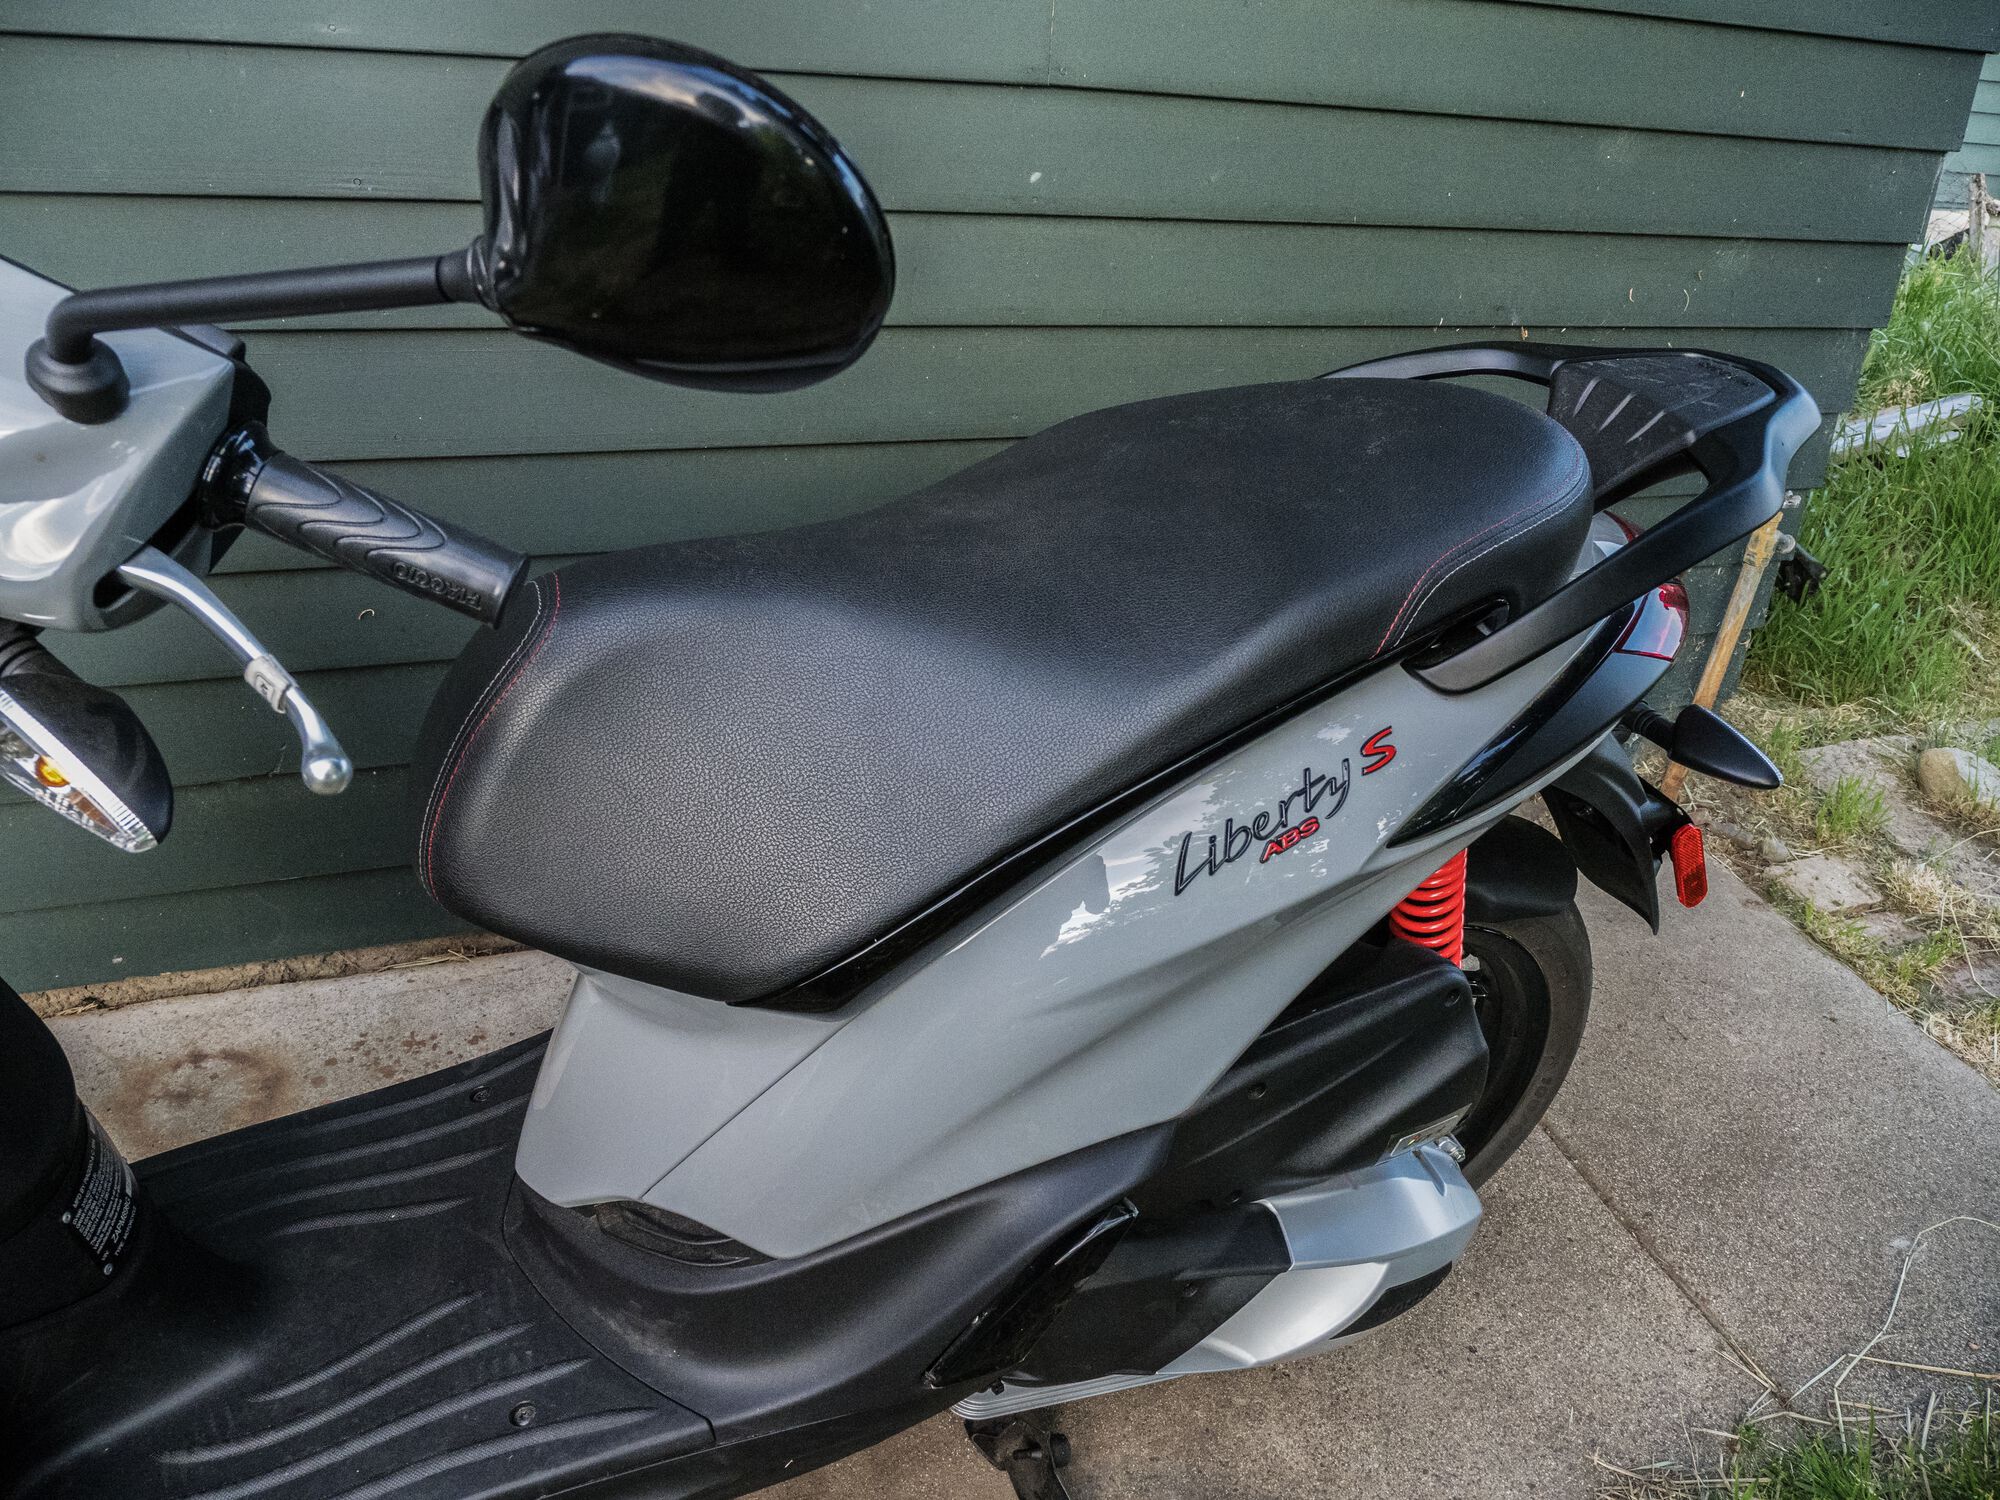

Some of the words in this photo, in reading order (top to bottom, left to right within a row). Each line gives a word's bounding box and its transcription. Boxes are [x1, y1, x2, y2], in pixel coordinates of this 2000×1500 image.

[1174, 758, 1351, 896] Liberty
[1360, 725, 1397, 776] S
[1259, 816, 1320, 864] ABS
